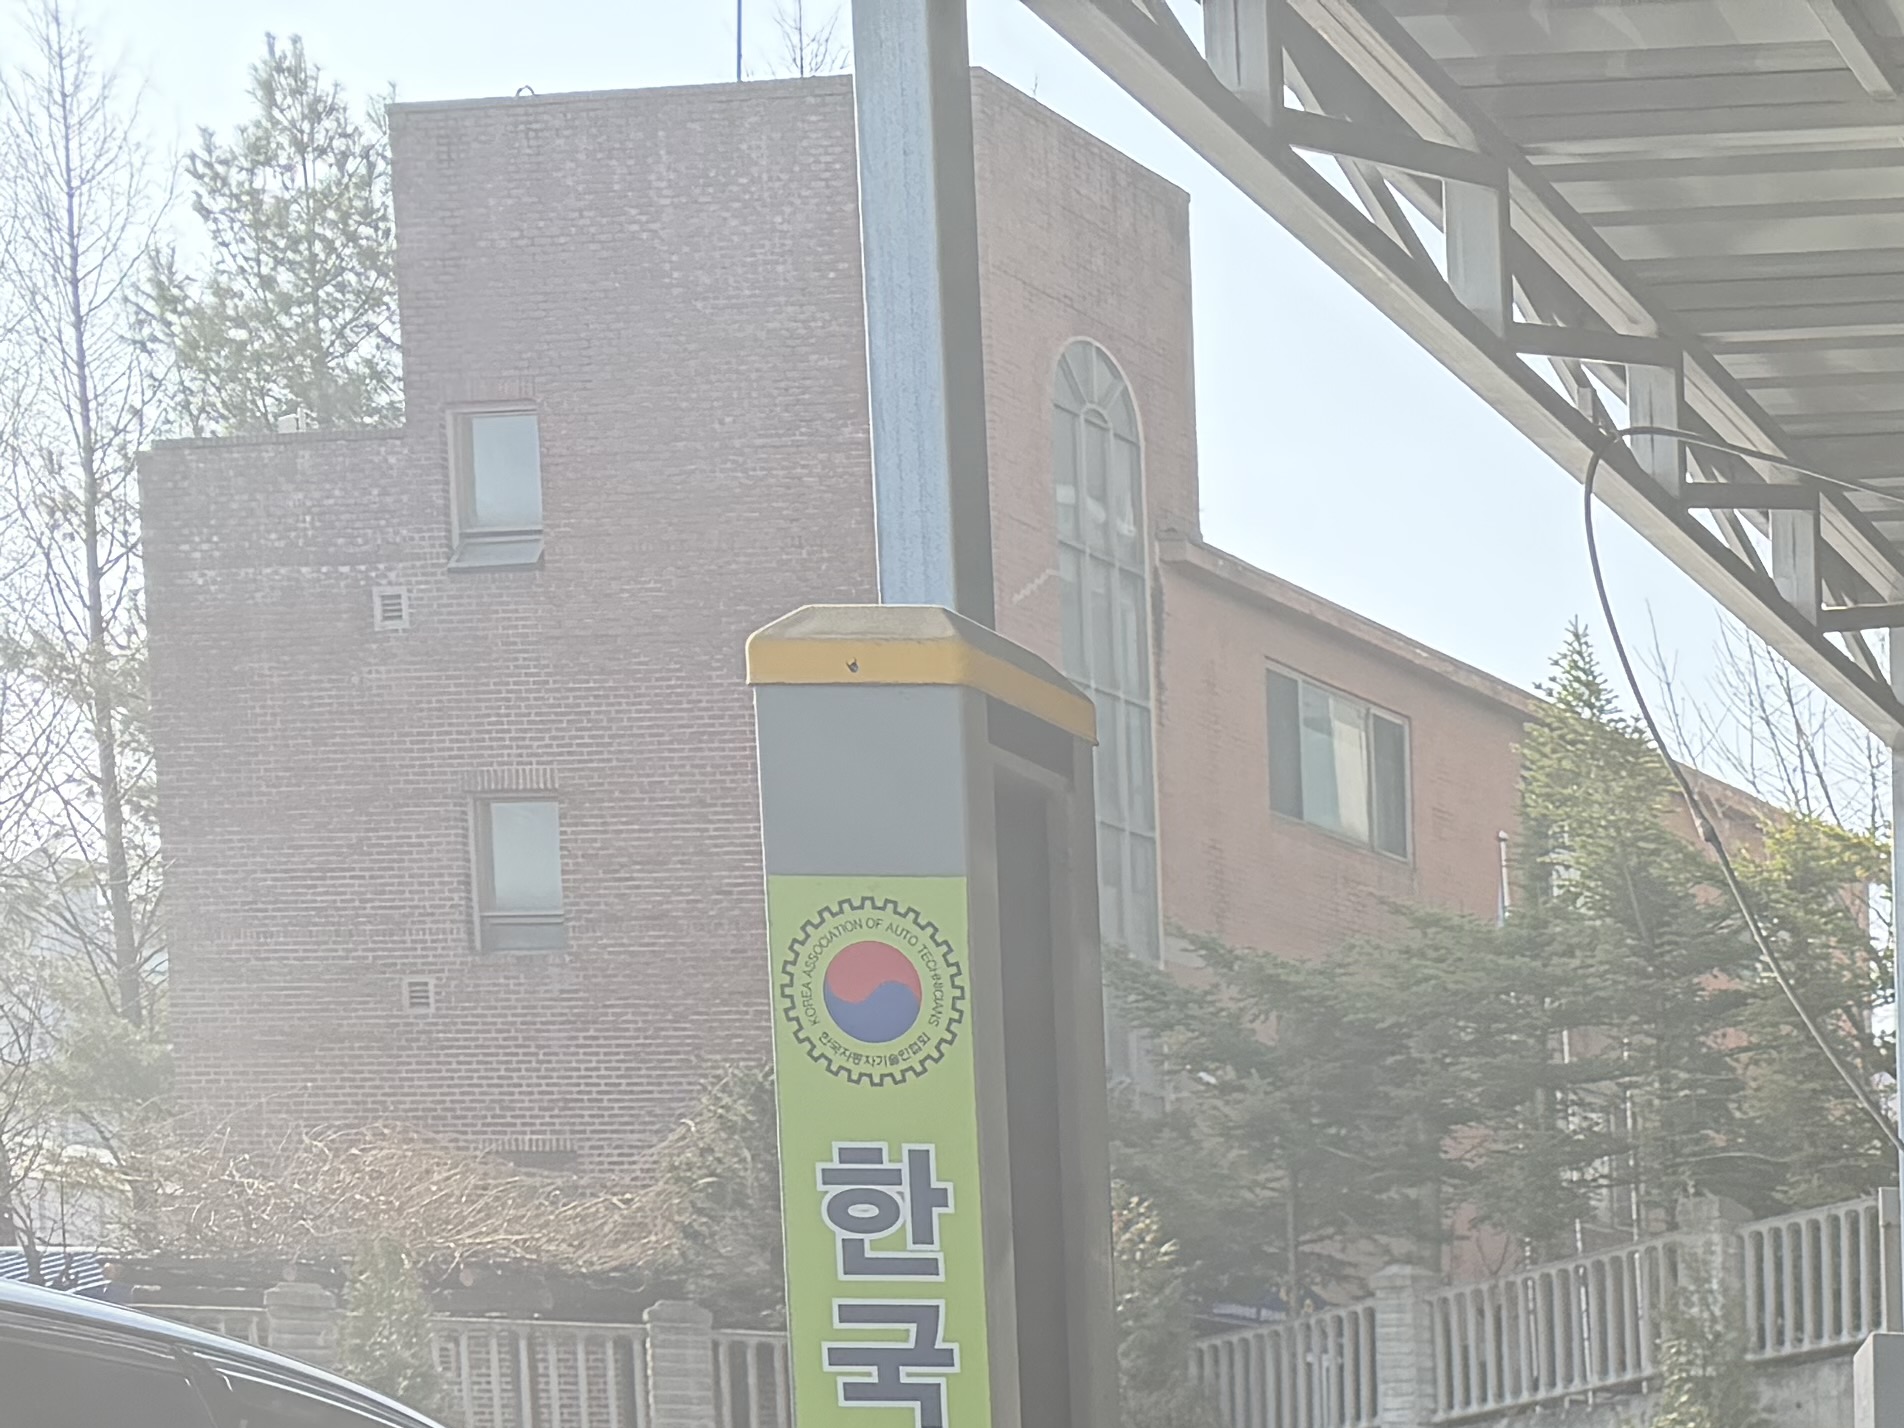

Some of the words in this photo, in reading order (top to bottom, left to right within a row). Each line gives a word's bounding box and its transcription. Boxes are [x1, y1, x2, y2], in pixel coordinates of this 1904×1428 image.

[865, 917, 884, 929] OF
[885, 922, 918, 947] AUTO
[803, 918, 863, 978] ASSOCIATION
[801, 982, 820, 1026] KOREA
